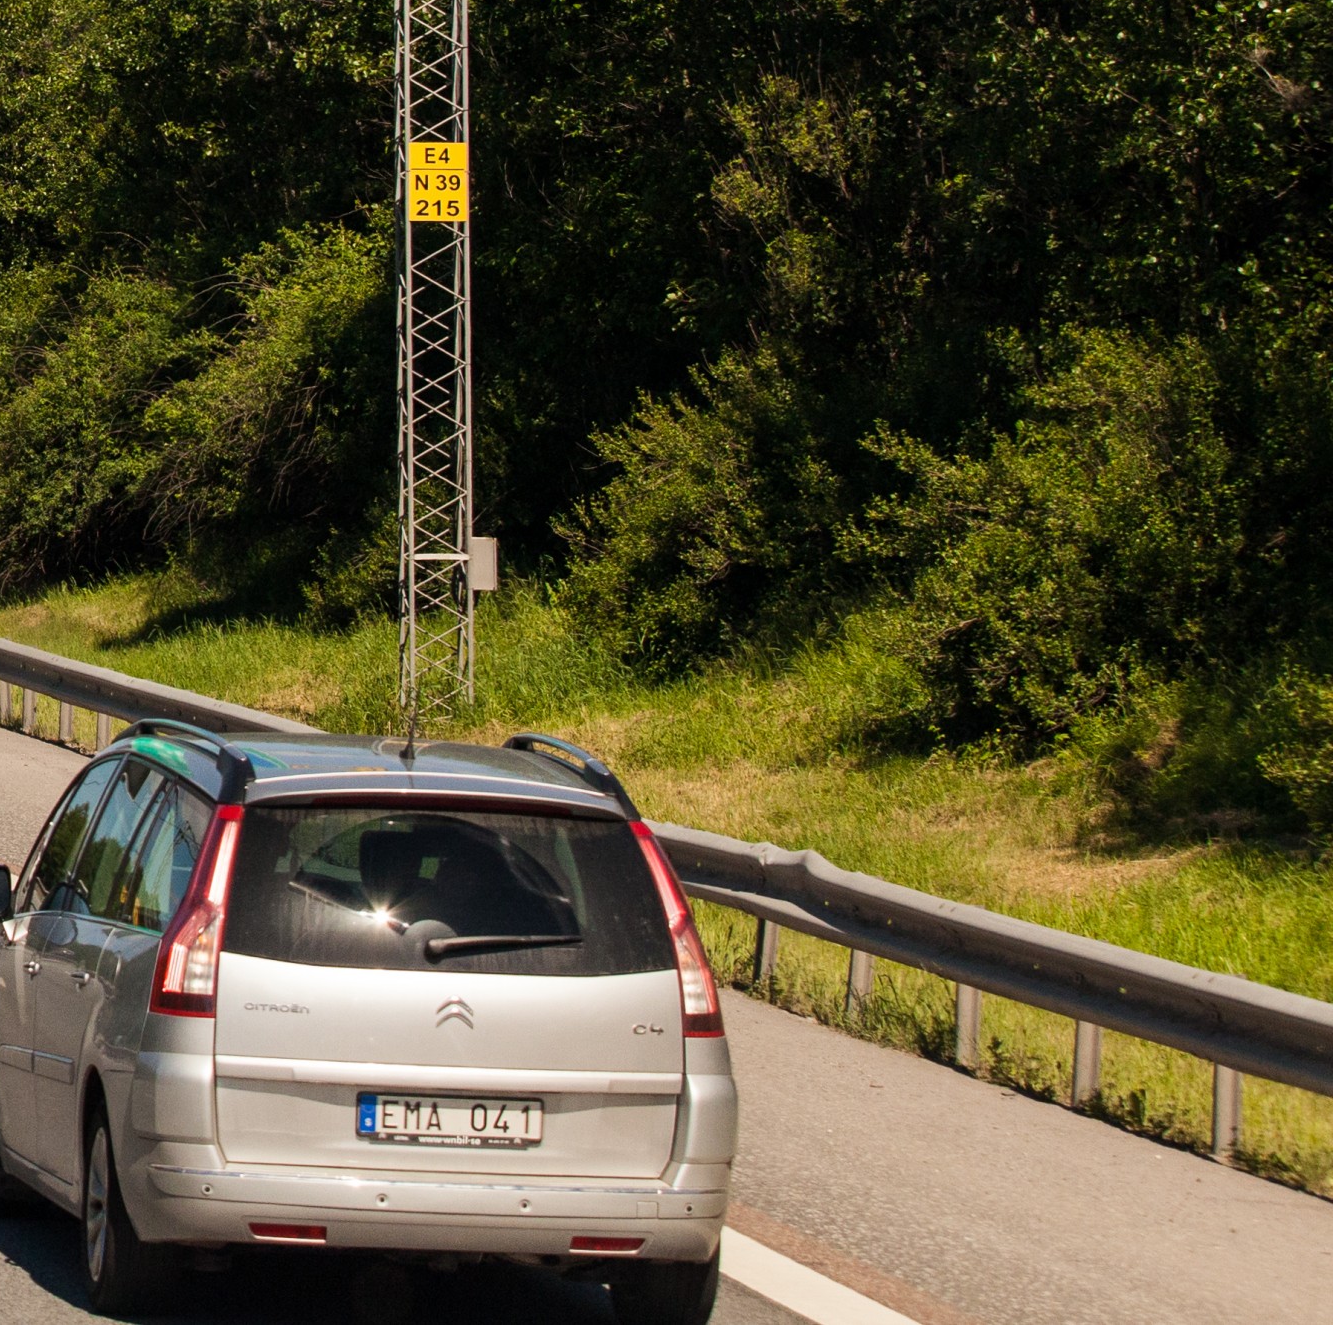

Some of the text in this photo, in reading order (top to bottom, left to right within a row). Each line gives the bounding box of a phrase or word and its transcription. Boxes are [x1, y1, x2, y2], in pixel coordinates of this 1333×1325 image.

[425, 147, 450, 164] E4
[415, 174, 461, 191] N 39
[416, 199, 460, 217] 215
[382, 1100, 531, 1134] EMA 041
